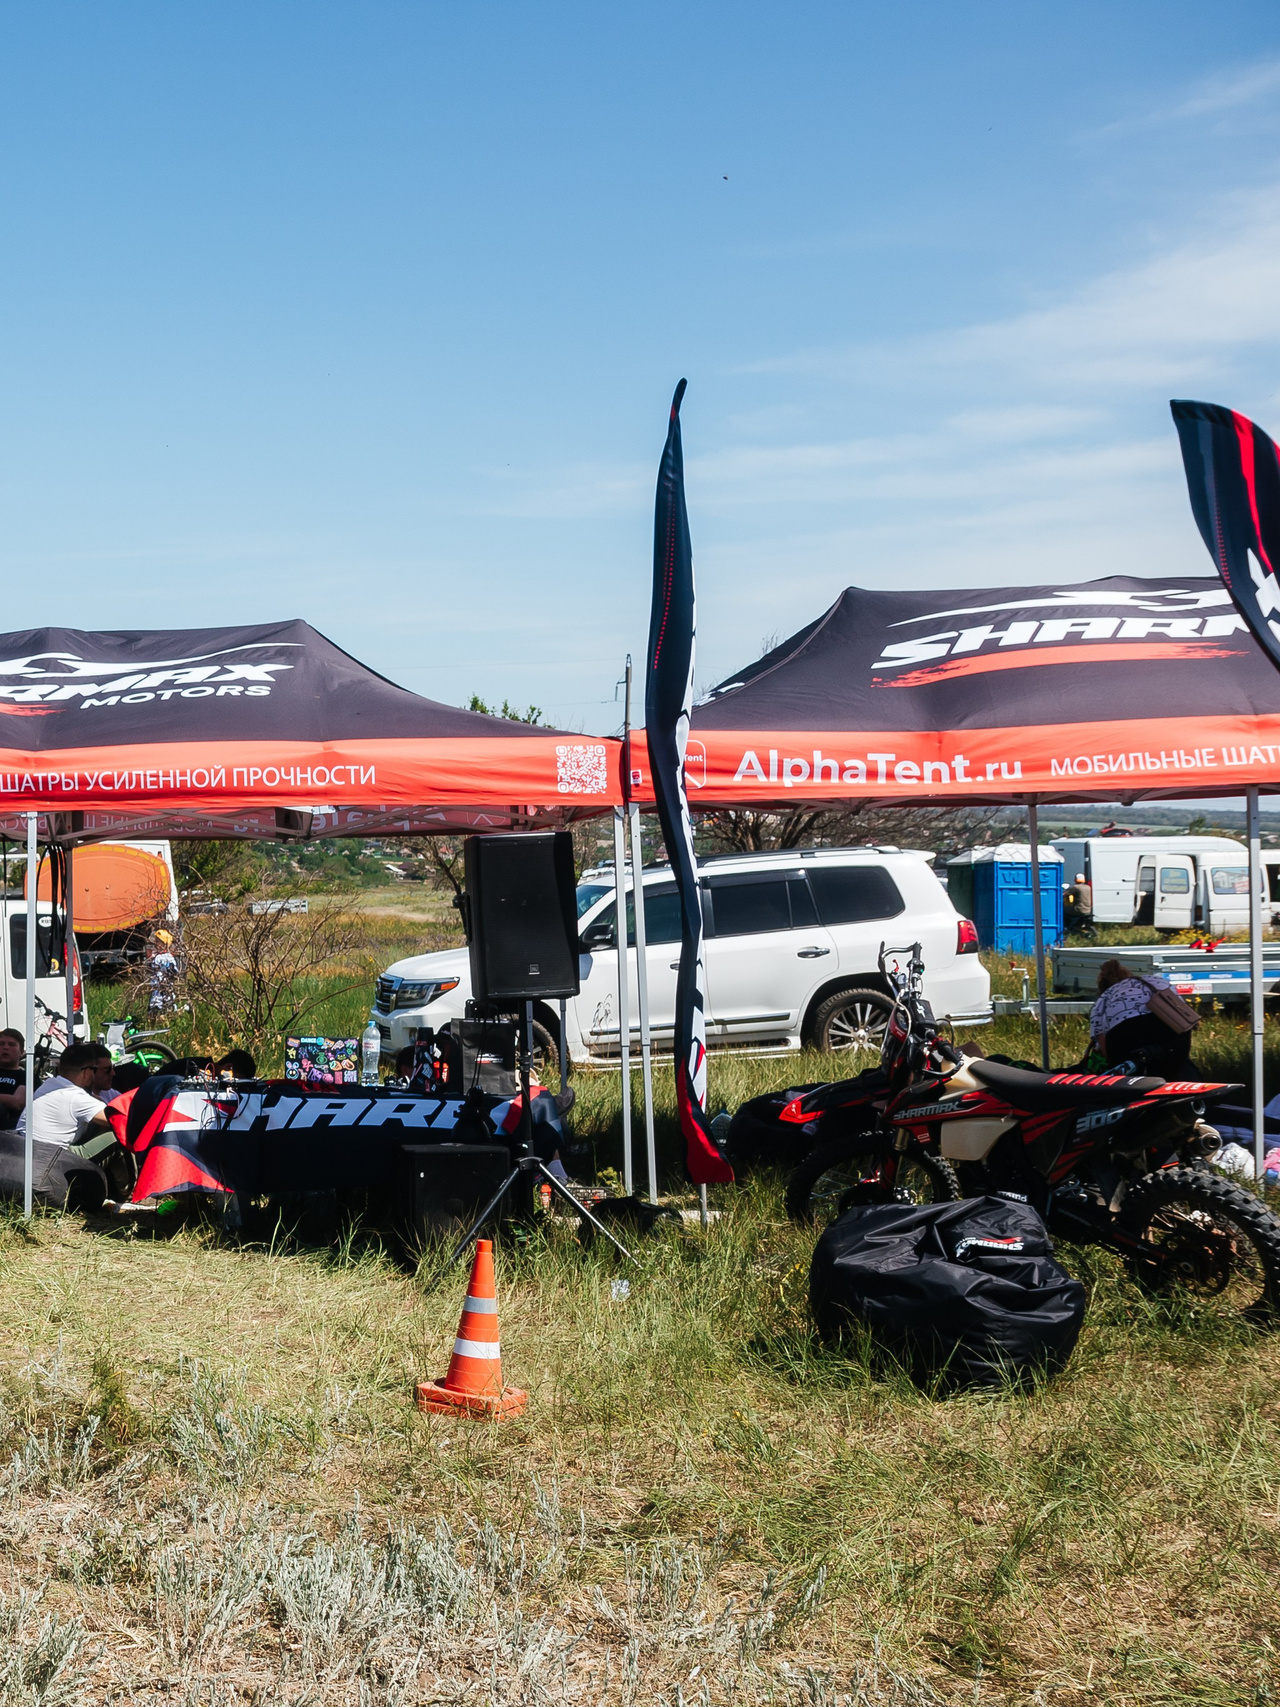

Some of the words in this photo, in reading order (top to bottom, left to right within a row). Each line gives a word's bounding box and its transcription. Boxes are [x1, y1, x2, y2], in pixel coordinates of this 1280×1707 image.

[80, 685, 272, 710] MOTORS
[732, 749, 1023, 787] AlphaTent.ru
[1050, 748, 1218, 776] МОБИЛЬНЫЕ
[1221, 745, 1280, 766] ШАТ
[0, 772, 79, 792] ШАТРЫ
[83, 764, 226, 791] УСИЛЕННОЙ
[232, 765, 376, 788] ПРОЧНОСТИ
[893, 1101, 963, 1120] SHARMAX
[1076, 1111, 1123, 1133] 300
